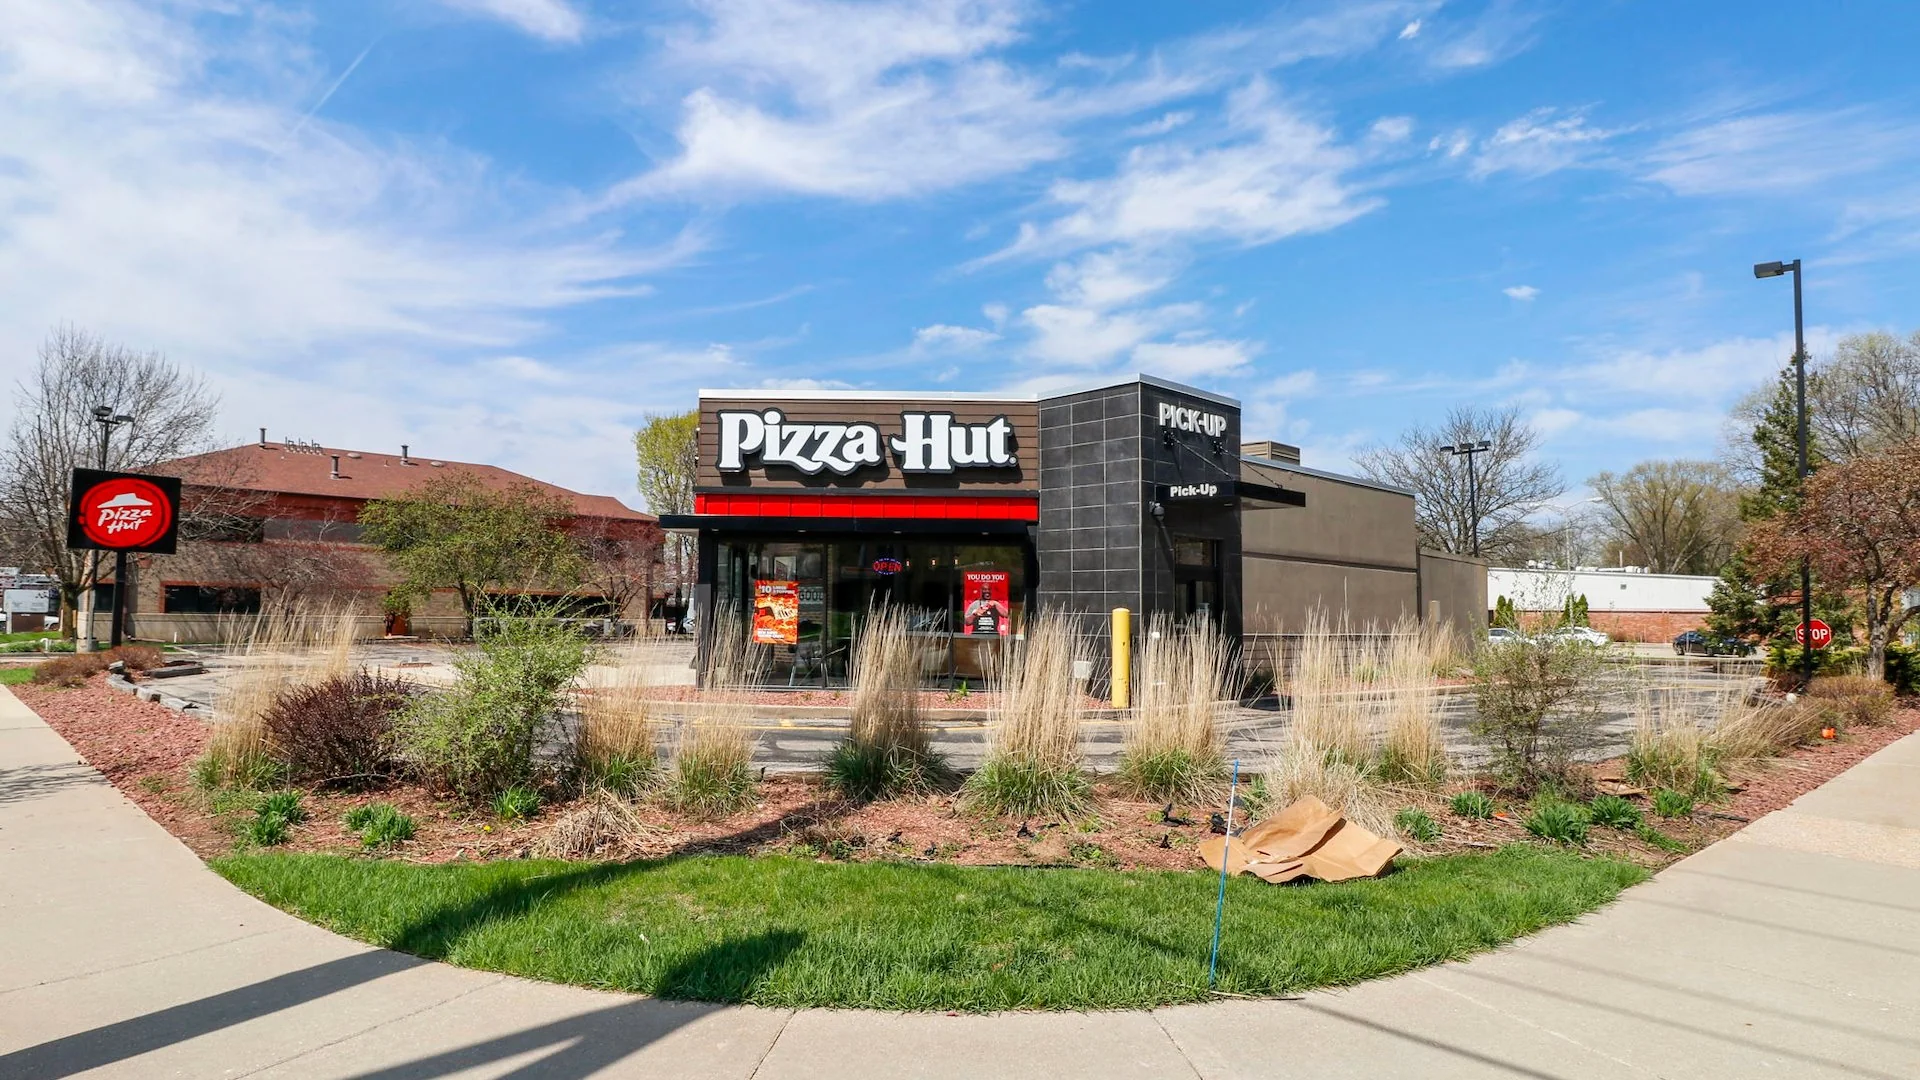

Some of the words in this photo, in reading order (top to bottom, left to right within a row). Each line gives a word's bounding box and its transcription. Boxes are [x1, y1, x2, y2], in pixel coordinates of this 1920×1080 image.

[1159, 402, 1227, 437] PICK-UP
[718, 409, 881, 473] Pizza
[890, 413, 1011, 470] Hut
[1170, 483, 1218, 497] Pick-Up
[98, 507, 152, 526] Pizza
[107, 518, 147, 534] Hut
[873, 561, 902, 572] OPEN
[1798, 628, 1828, 640] SOP
